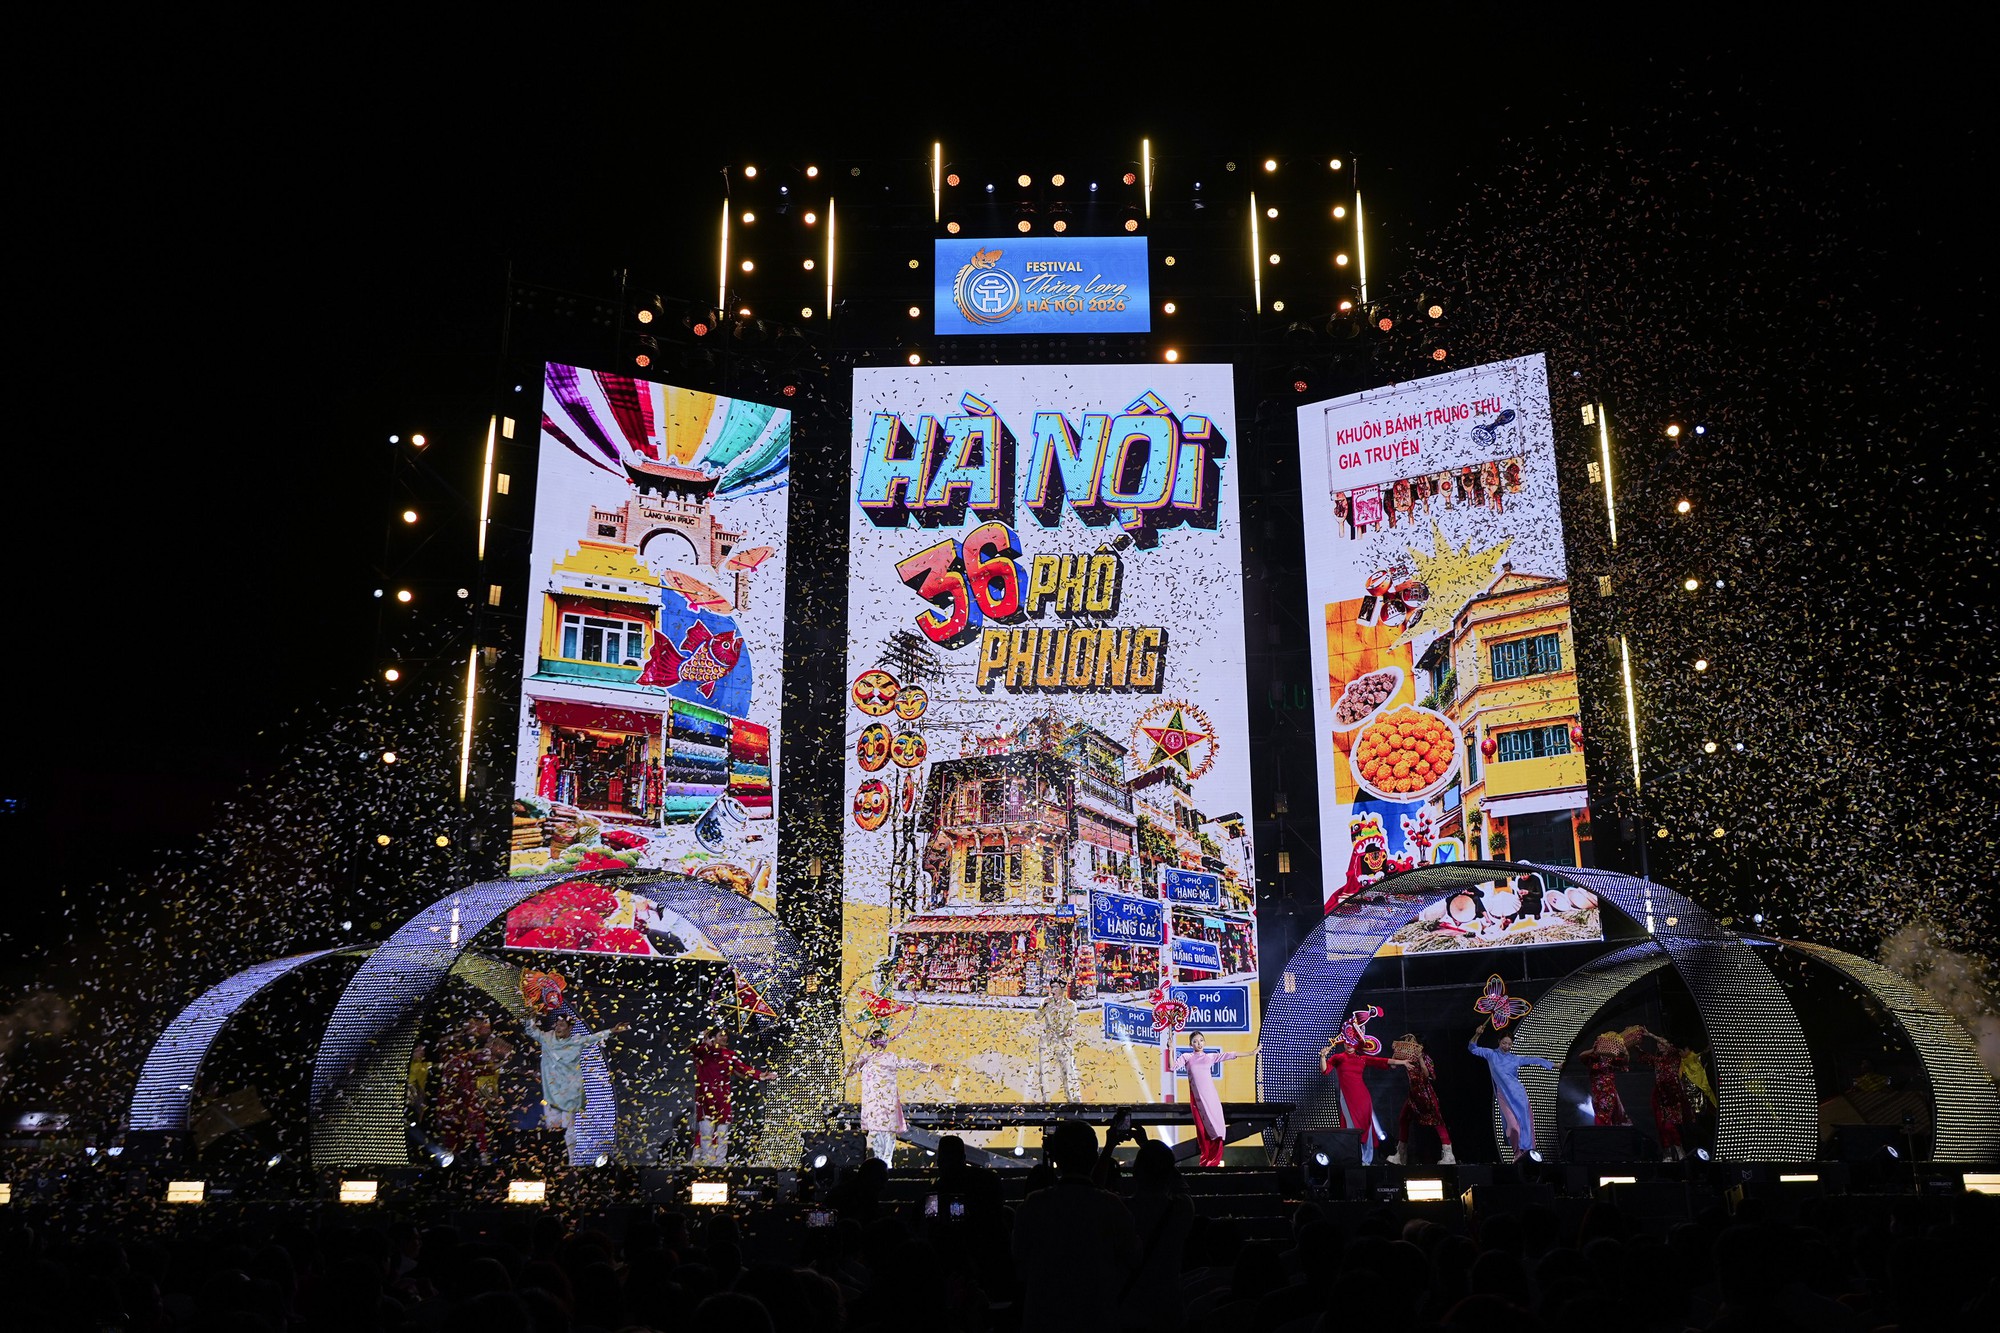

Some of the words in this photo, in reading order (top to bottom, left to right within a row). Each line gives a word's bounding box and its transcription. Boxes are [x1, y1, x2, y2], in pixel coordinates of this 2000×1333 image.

[1026, 261, 1083, 272] FESTIVAL
[1023, 273, 1084, 300] Thăng
[1026, 297, 1050, 312] HÀ
[1054, 297, 1084, 315] NỘI
[1089, 299, 1126, 312] 2026
[1385, 413, 1422, 436] BÁNH
[1426, 403, 1469, 427] TRUNG
[1472, 397, 1501, 417] THU
[857, 390, 1010, 522] HÀ
[1338, 452, 1362, 470] GIA
[894, 520, 1028, 649] 36
[1026, 534, 1131, 620] PHỐ
[976, 619, 1168, 694] PHƯỜNG
[1187, 877, 1202, 885] PHỐ
[1177, 885, 1198, 899] HÀNG
[1199, 888, 1211, 900] MÃ
[1123, 903, 1144, 916] PHỐ
[1107, 915, 1138, 936] HÀNG
[1199, 991, 1221, 1003] PHỐ
[1128, 1012, 1145, 1022] PHỐ
[1214, 1006, 1237, 1023] NÓN
[1111, 1020, 1135, 1036] HÀNG
